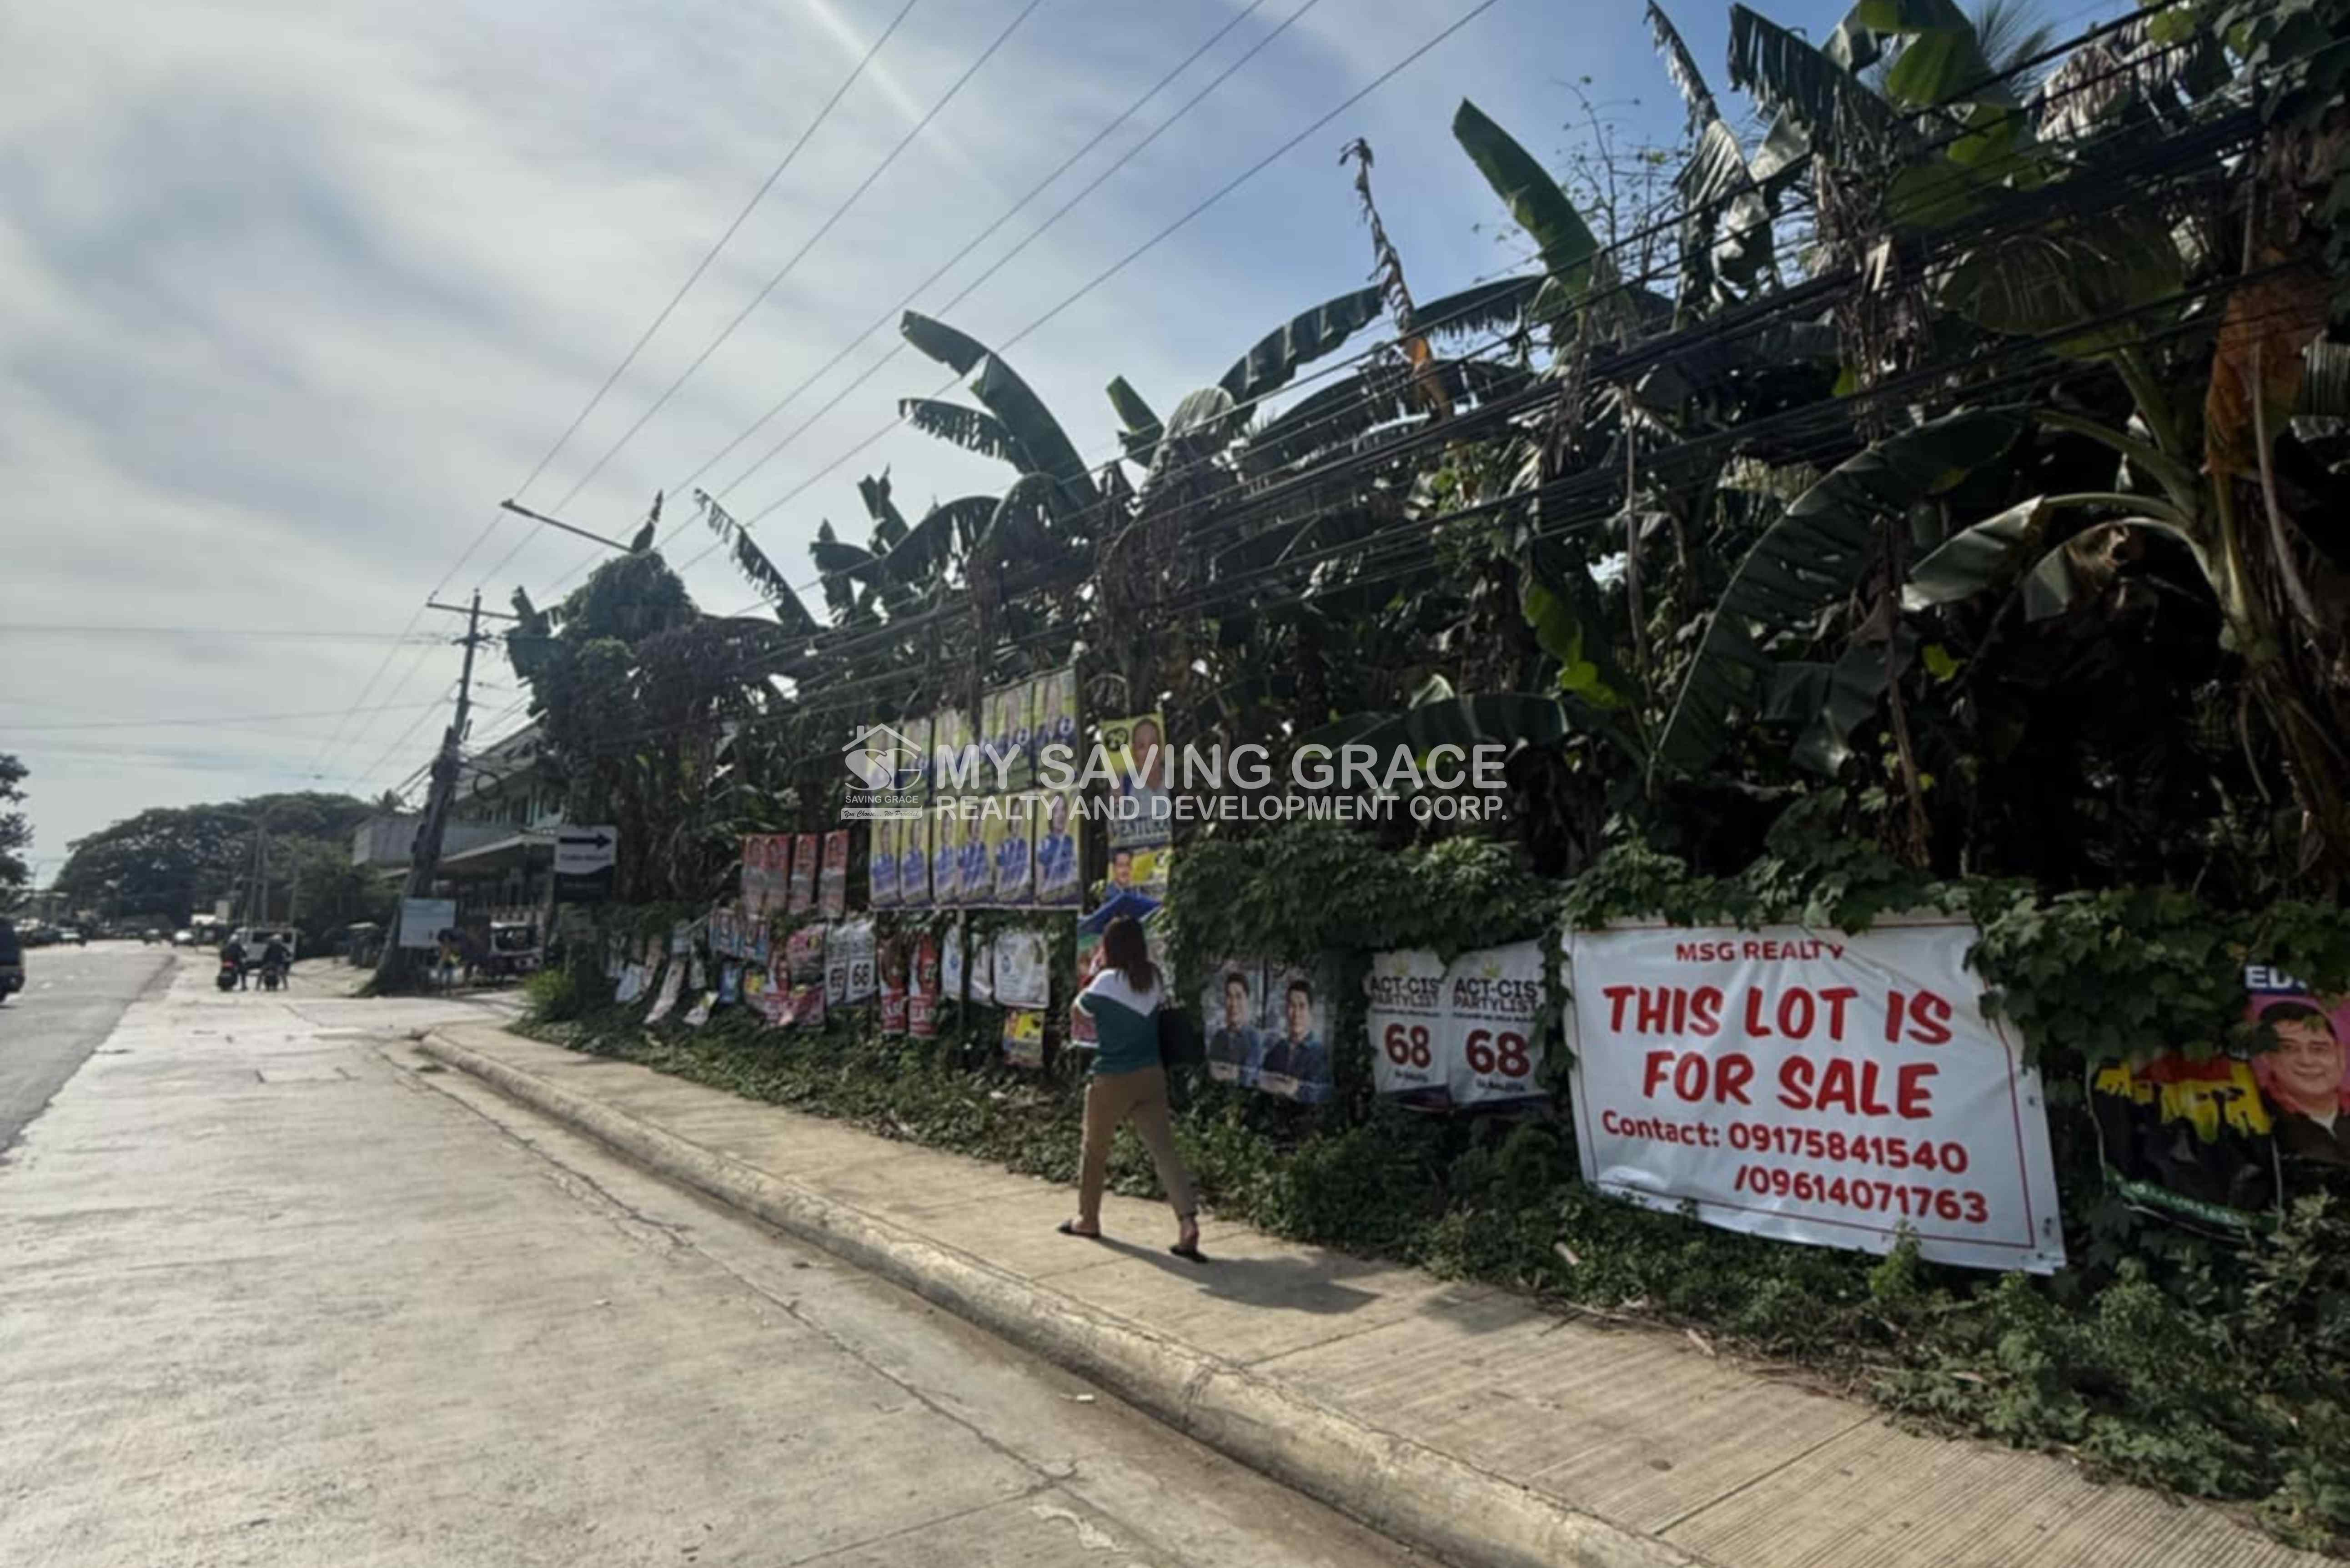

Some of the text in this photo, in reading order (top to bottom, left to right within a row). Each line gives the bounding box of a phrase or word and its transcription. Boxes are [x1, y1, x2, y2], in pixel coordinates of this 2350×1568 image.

[1676, 941, 1844, 961] MSG REALTY
[1370, 976, 1440, 995] ACT-CIS
[1454, 976, 1538, 999] ACT-CIS
[1602, 986, 1953, 1045] THIS LOT IS
[1385, 1023, 1431, 1069] 68
[1466, 1029, 1531, 1078] 68
[1642, 1050, 1940, 1119] FOR SALE
[1602, 1110, 1968, 1173] Contact: 09175841540
[1734, 1163, 1989, 1223] /09614071763
